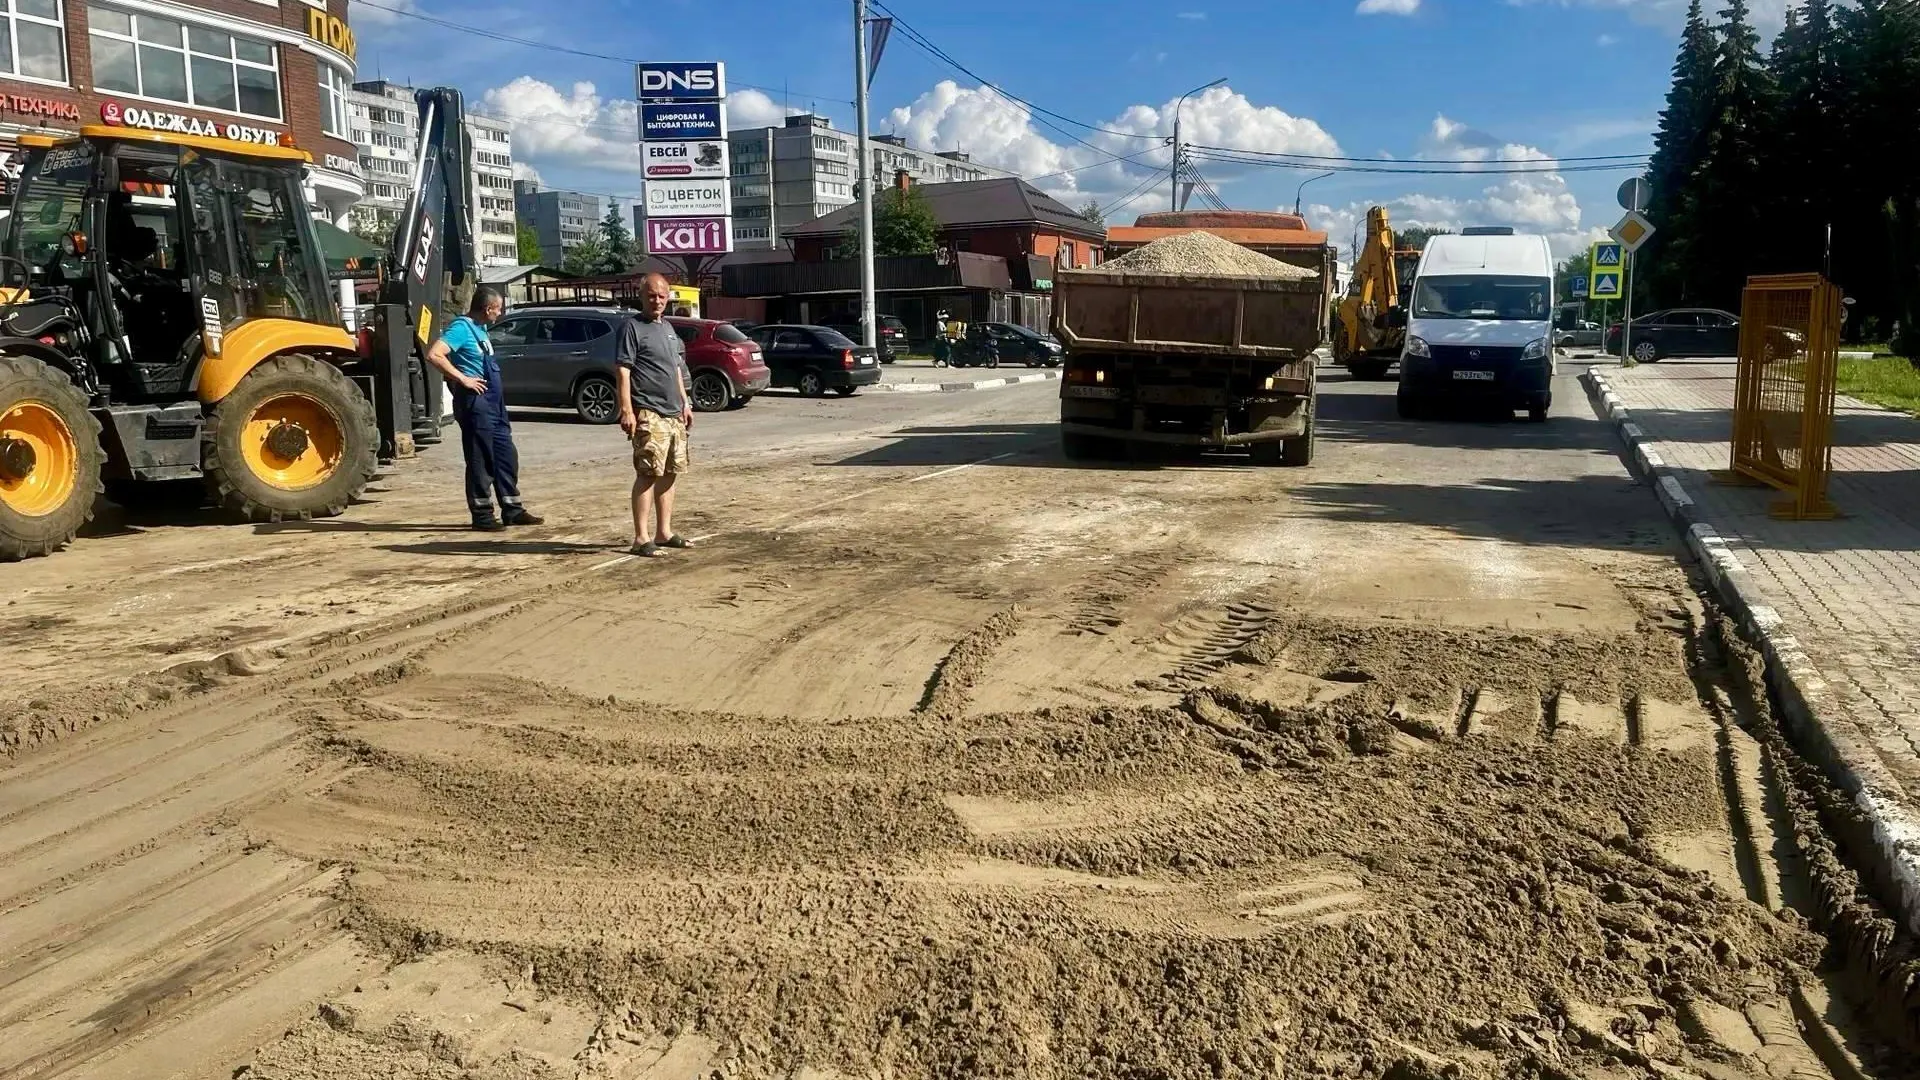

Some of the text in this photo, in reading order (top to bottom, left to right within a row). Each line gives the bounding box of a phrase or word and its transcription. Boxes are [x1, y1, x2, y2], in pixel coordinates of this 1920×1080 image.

[643, 70, 715, 90] DNS
[10, 93, 80, 120] ТЕХНИКА
[656, 113, 697, 121] ЦИФРОВАЯ
[124, 107, 218, 138] ОДЕЖДА
[650, 142, 687, 157] ЕВСЕЙ
[668, 188, 721, 202] ЦВЕТОК
[654, 222, 720, 249] kari
[414, 217, 434, 280] ELAZ
